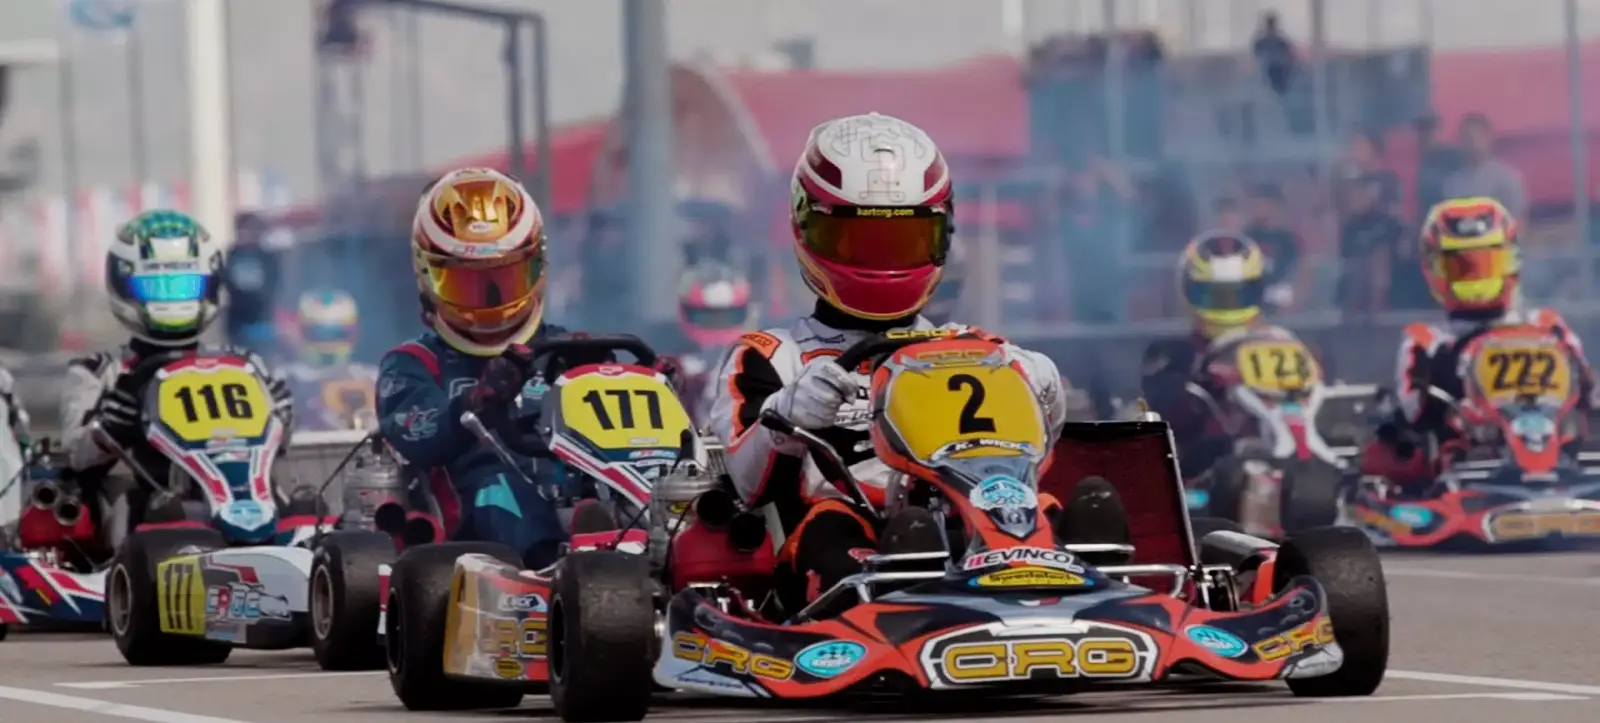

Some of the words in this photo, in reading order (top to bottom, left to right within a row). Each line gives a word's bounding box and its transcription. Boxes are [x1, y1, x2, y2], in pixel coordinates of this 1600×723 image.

[1487, 350, 1560, 391] 222
[174, 383, 253, 423] 116
[582, 389, 664, 430] 177
[947, 373, 997, 434] 2
[164, 563, 193, 630] 177
[673, 633, 792, 681] CRG
[943, 640, 1138, 680] CRG
[1254, 616, 1334, 661] CRG
